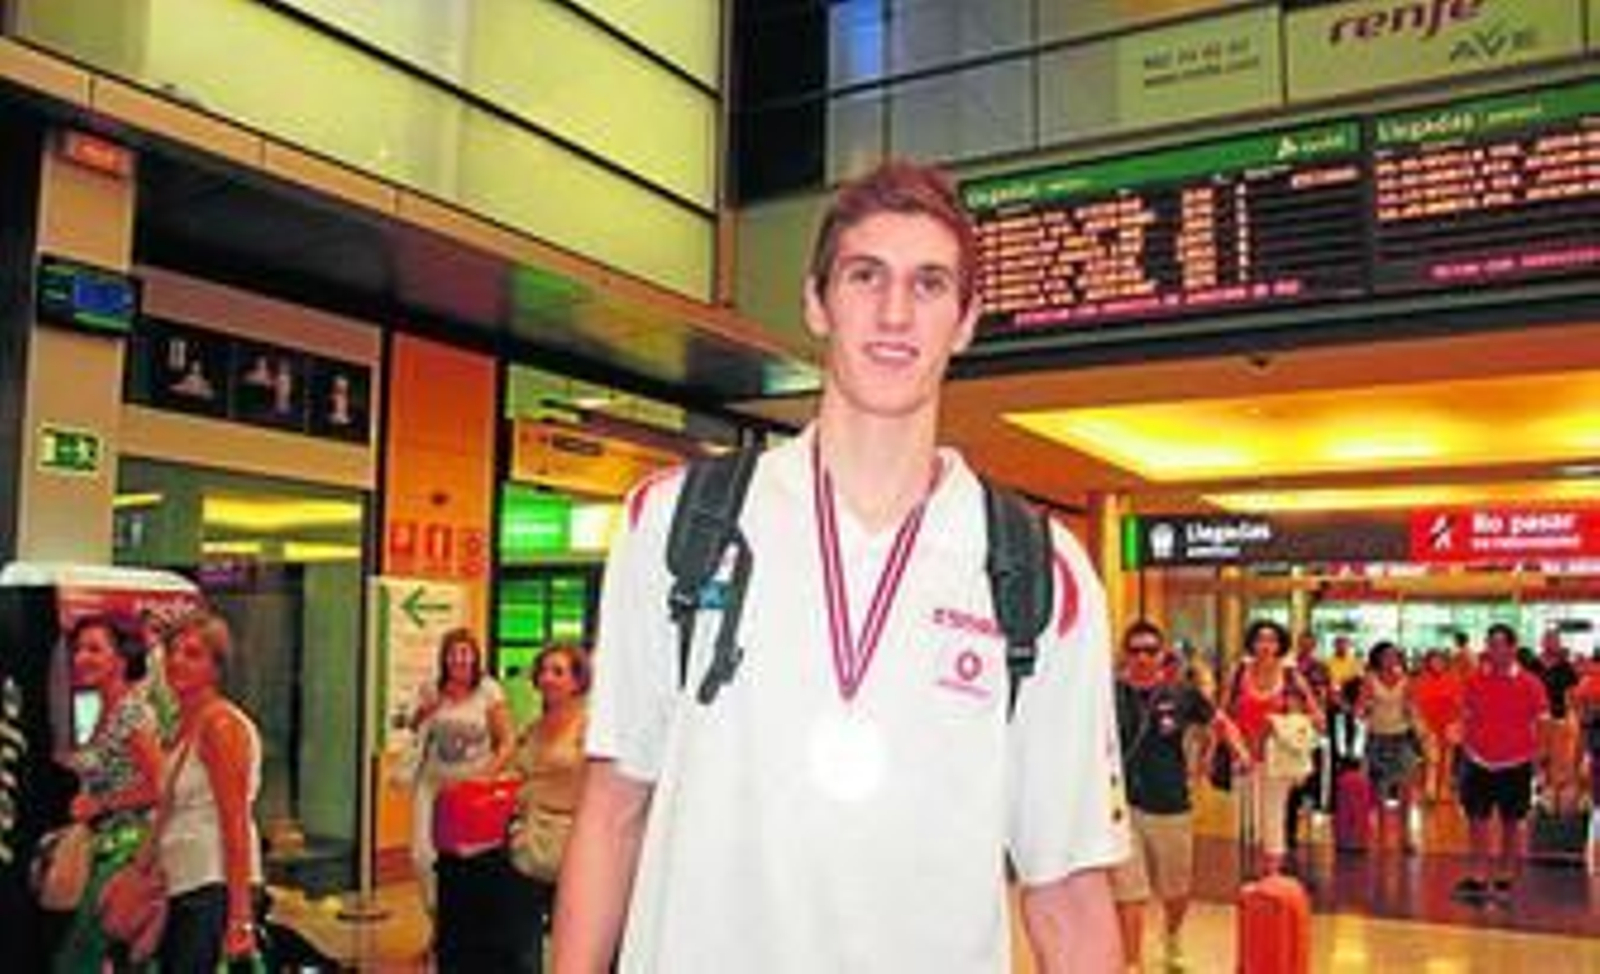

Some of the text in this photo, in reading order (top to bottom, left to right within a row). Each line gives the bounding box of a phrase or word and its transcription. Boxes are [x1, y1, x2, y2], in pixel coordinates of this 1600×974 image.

[1329, 0, 1481, 46] renfe
[1376, 112, 1476, 144] Llegadas
[1186, 521, 1270, 544] Llegadas
[1510, 512, 1575, 538] pasar
